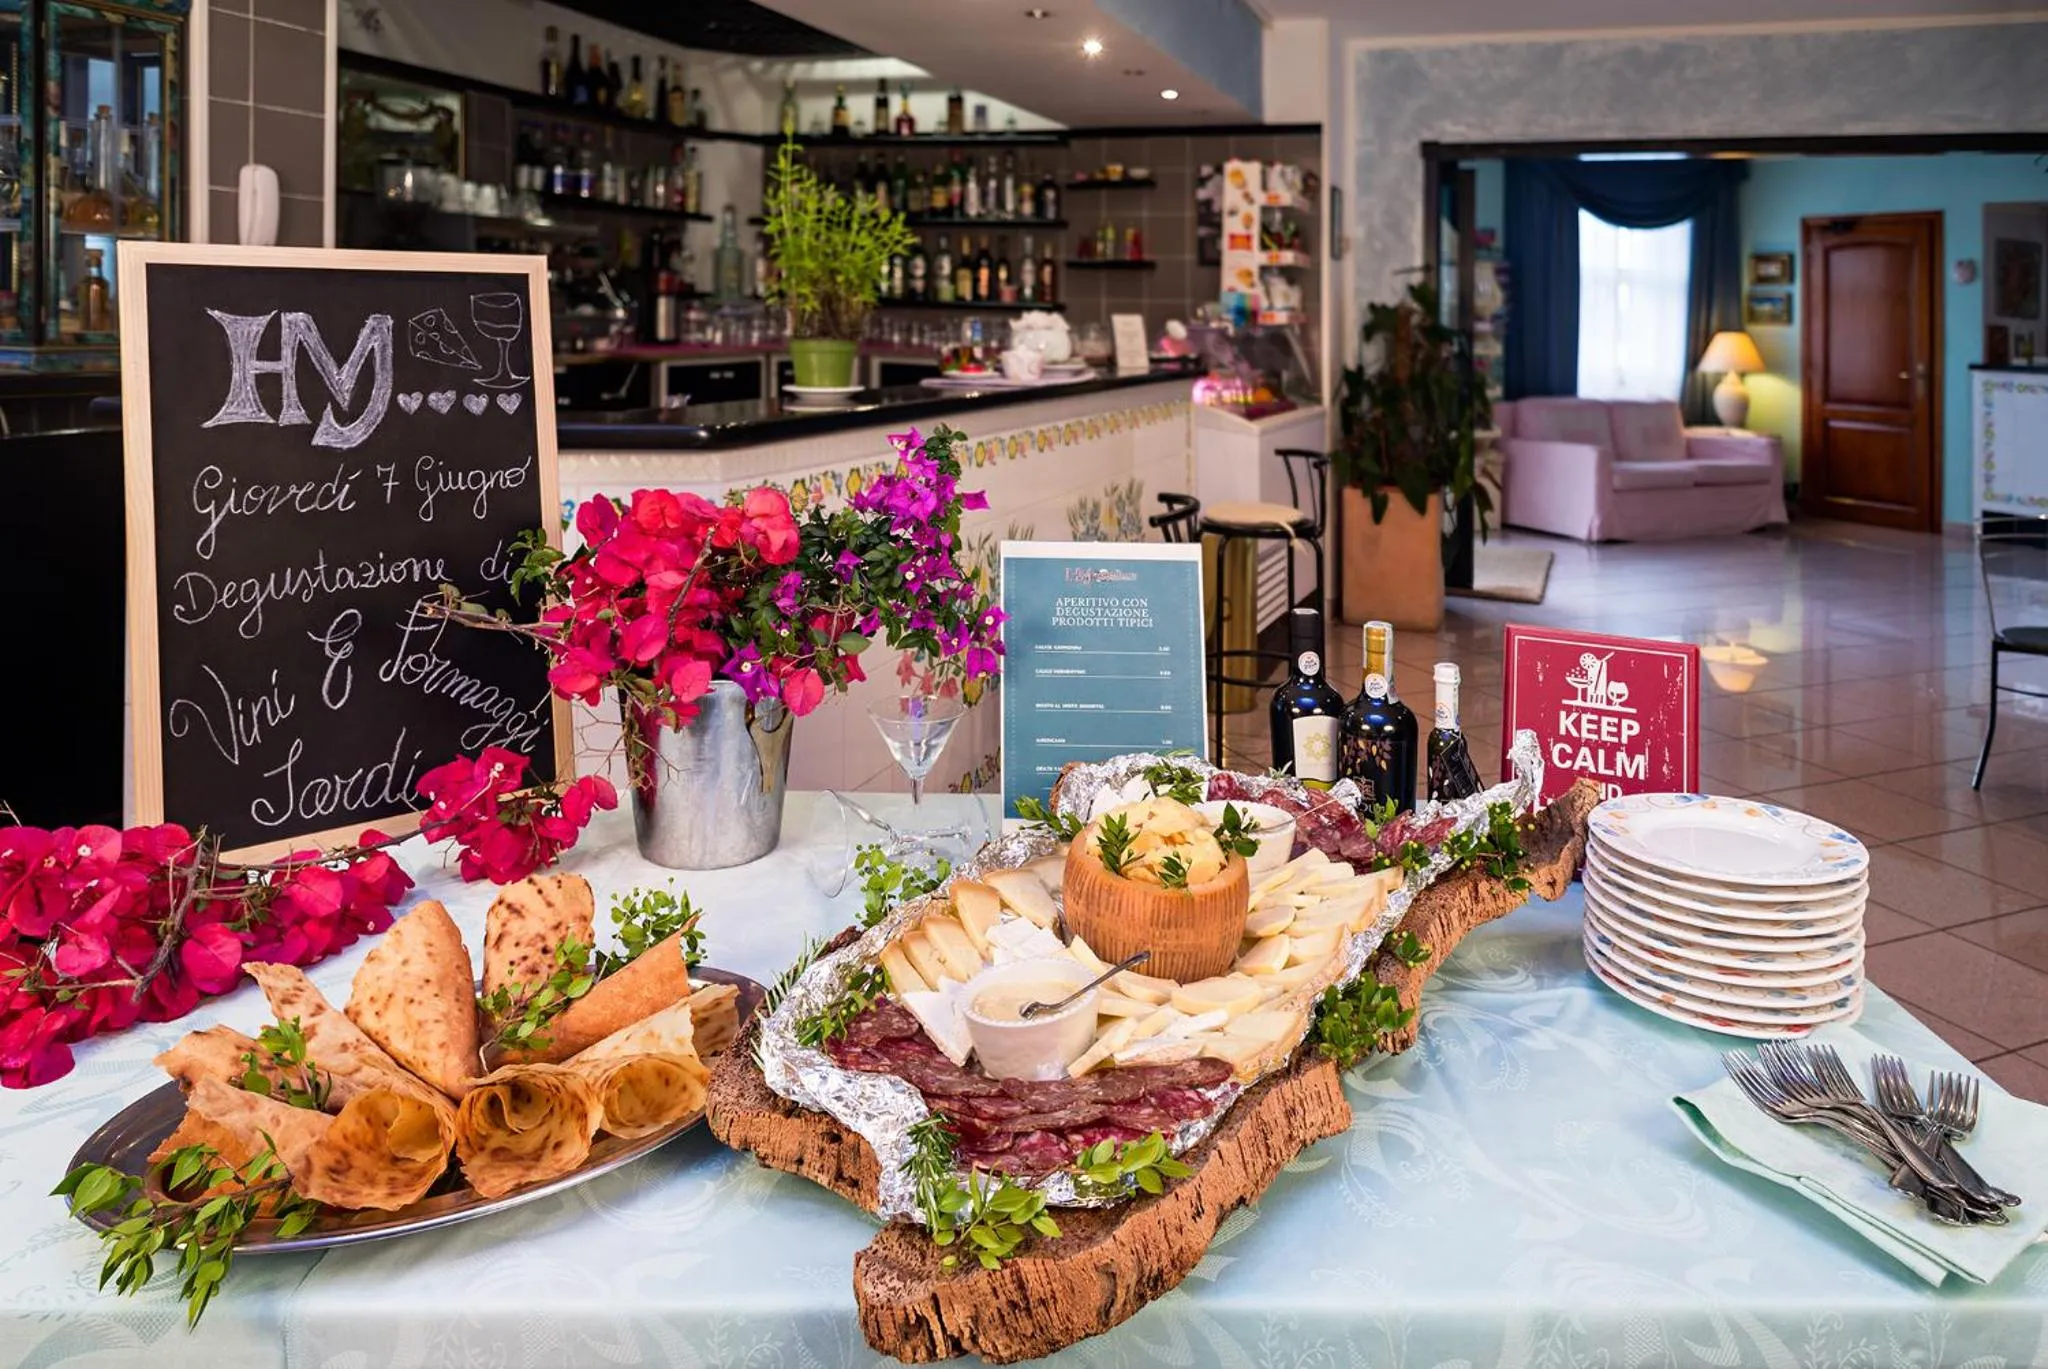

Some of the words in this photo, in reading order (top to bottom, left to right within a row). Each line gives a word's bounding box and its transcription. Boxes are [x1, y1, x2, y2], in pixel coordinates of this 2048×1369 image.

[375, 462, 400, 504] 7
[414, 455, 533, 522] Giugno
[173, 548, 455, 639] Degustazione
[479, 539, 514, 584] di
[1055, 596, 1119, 607] APERITIVO
[1121, 597, 1149, 608] CON
[1051, 616, 1114, 627] PRODOTTI
[1117, 617, 1154, 628] TIPICI
[1055, 606, 1150, 618] DEGUSTAZIONE
[378, 592, 551, 754] Formaggi
[168, 664, 296, 765] Vini
[1558, 709, 1641, 745] KEEP
[1551, 742, 1646, 781] CALM
